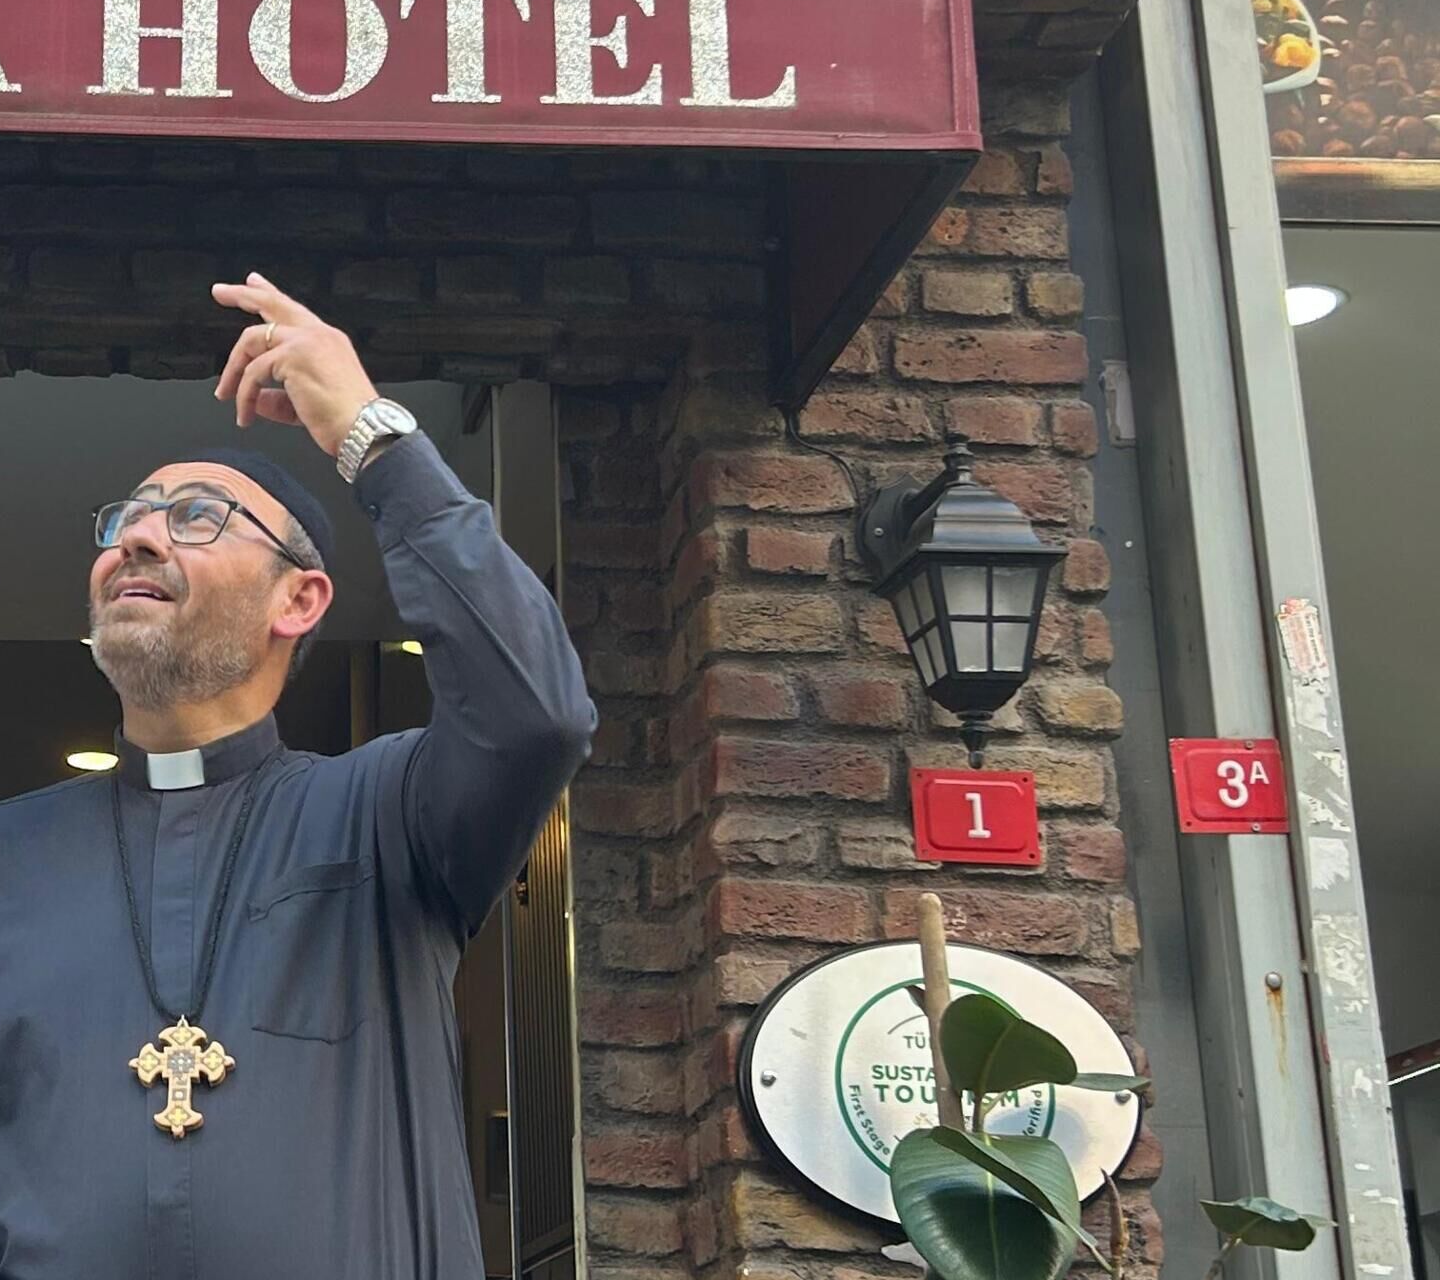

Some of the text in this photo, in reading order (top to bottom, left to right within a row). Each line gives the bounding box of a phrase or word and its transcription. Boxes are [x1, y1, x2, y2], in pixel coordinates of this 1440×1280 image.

[964, 792, 991, 839] 1
[849, 1084, 891, 1156] First Stage
